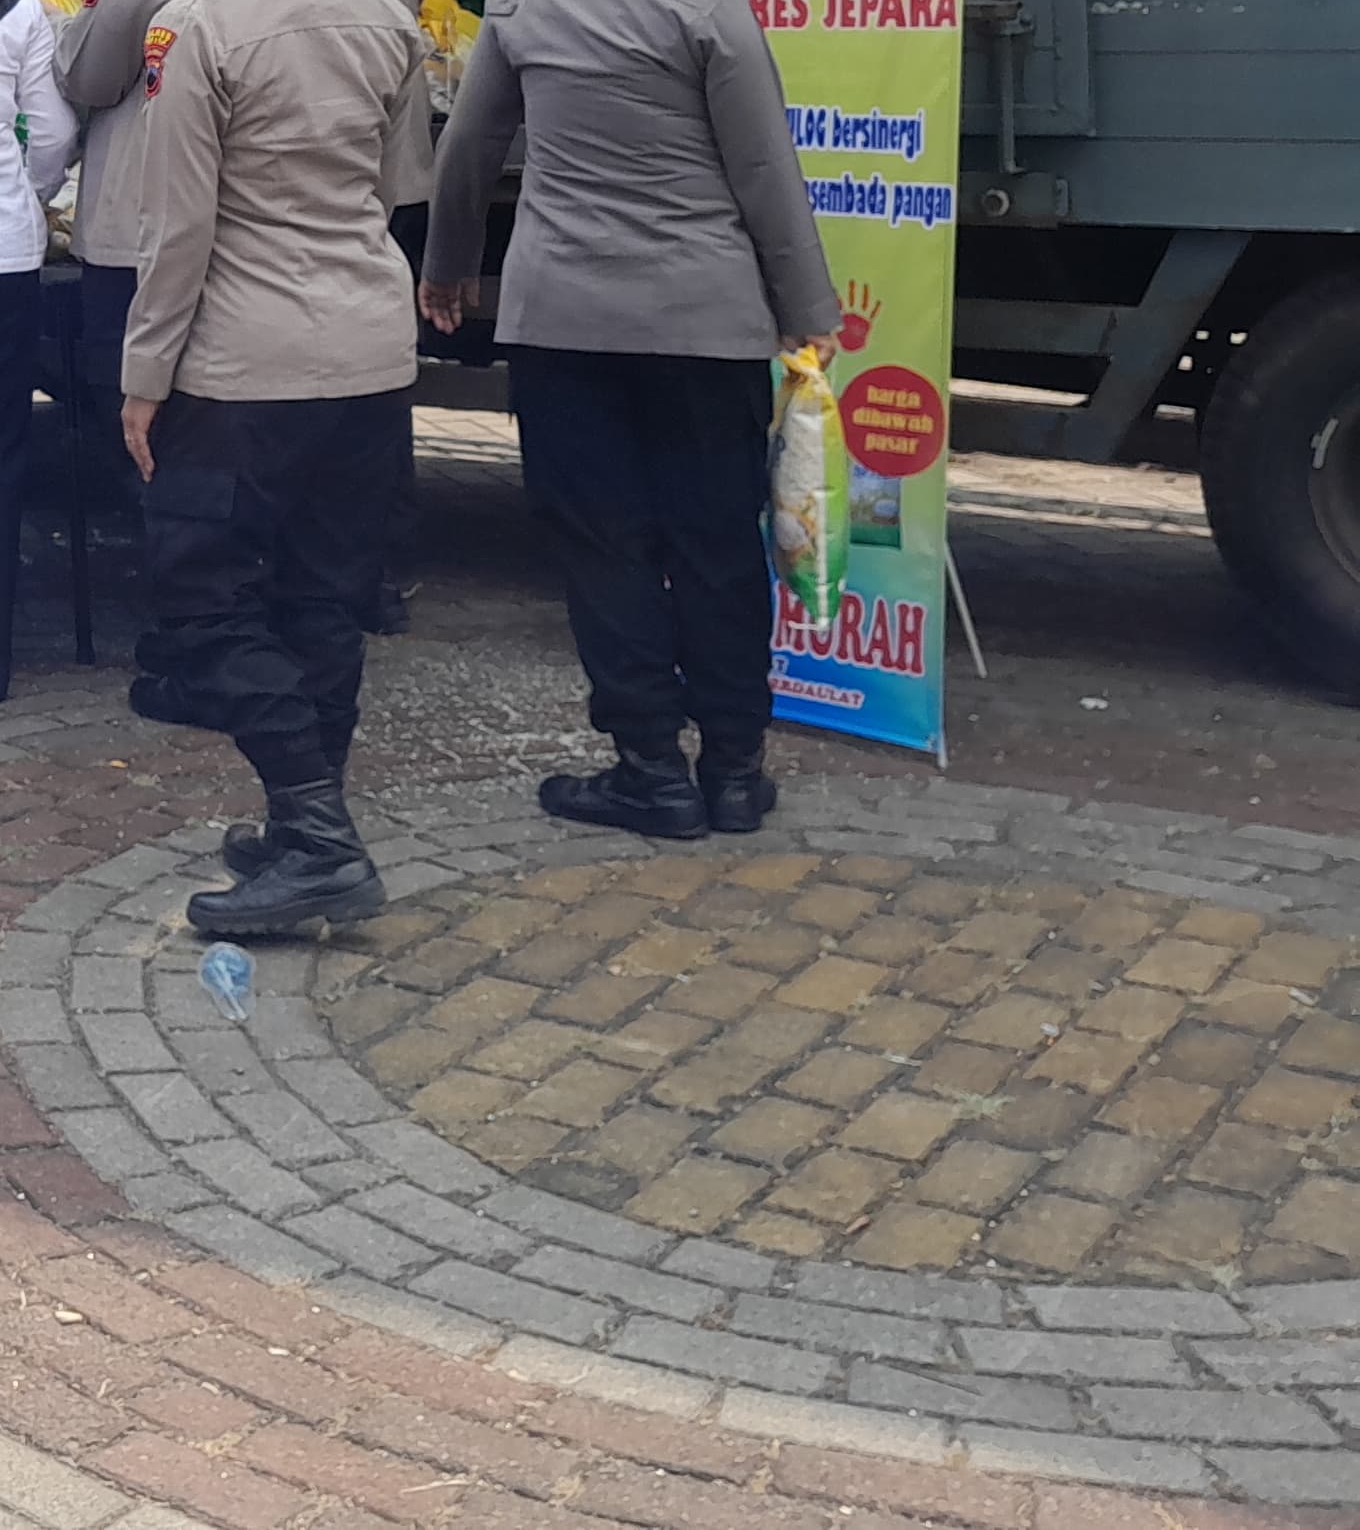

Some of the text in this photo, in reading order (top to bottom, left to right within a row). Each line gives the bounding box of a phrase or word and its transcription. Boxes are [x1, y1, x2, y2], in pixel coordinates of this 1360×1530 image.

[784, 107, 922, 158] ULOG bersinergi
[805, 173, 952, 226] sembada pangan
[770, 678, 863, 706] ERDAULAT
